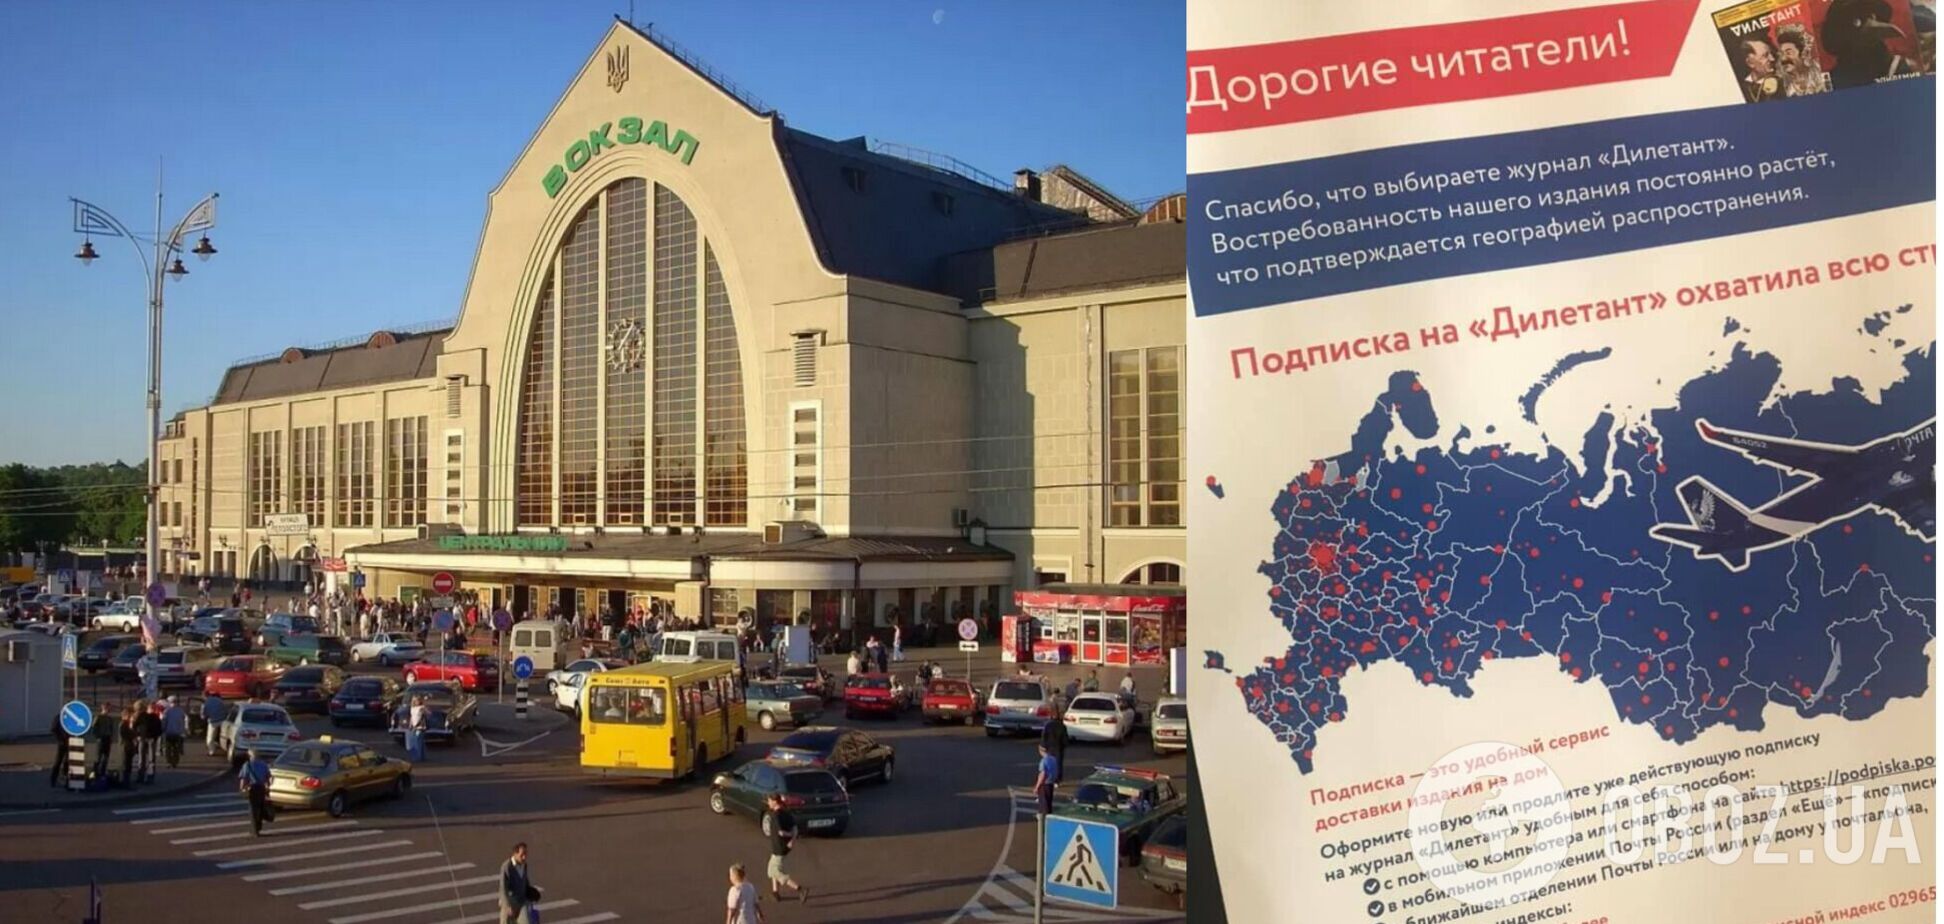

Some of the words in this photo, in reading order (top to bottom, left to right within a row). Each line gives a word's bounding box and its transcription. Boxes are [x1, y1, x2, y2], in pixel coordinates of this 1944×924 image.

[1186, 58, 1397, 113] Дорогие
[1410, 19, 1631, 79] читатели!
[541, 116, 700, 198] ВОКЗАЛ
[1205, 190, 1320, 221] Спасибо,
[1326, 184, 1366, 204] что
[1374, 166, 1501, 197] выбираете
[1507, 154, 1591, 181] журнал
[1598, 137, 1735, 167] «Дилетант».
[1211, 205, 1442, 254] Востребованность
[1448, 194, 1532, 219] нашего
[1538, 180, 1630, 207] издания
[1636, 165, 1753, 193] постоянно
[1759, 149, 1836, 179] растёт,
[1216, 266, 1259, 287] что
[1266, 234, 1466, 279] подтверждается
[1473, 212, 1606, 248] географией
[1612, 185, 1810, 232] распространения.
[1231, 331, 1411, 379] Подписка
[1420, 323, 1459, 347] на
[1469, 291, 1667, 341] «Дилетант»
[1675, 265, 1820, 307] охватила
[1827, 252, 1890, 281] всю
[1310, 773, 1405, 806] Подписка
[1430, 761, 1460, 779] это
[1464, 738, 1545, 774] удобный
[1549, 725, 1610, 751] сервис
[1315, 799, 1402, 833] доставки
[1407, 781, 1484, 809] издания
[1488, 775, 1508, 791] на
[1513, 766, 1548, 785] дом
[1320, 829, 1413, 859] Оформите
[1417, 814, 1473, 838] новую
[1512, 785, 1590, 813] продлите
[1593, 776, 1625, 796] уже
[1629, 749, 1741, 787] действующую
[1744, 732, 1820, 759] подписку
[1325, 867, 1345, 882] на
[1349, 851, 1414, 877] журнал
[1418, 826, 1519, 858] «Дилетант»
[1523, 807, 1597, 836] удобным
[1601, 798, 1629, 815] для
[1633, 786, 1669, 805] себя
[1672, 767, 1755, 795] способом:
[1384, 878, 1393, 890] с
[1397, 858, 1479, 886] помощью
[1483, 830, 1583, 866] компьютера
[1587, 823, 1618, 839] или
[1621, 801, 1706, 830] смартфона
[1711, 795, 1729, 809] на
[1733, 786, 1776, 804] сайте
[1388, 901, 1397, 913] в
[1402, 877, 1498, 910] мобильном
[1502, 849, 1605, 885] приложении
[1609, 834, 1661, 857] Почты
[1666, 820, 1722, 842] России
[1509, 872, 1597, 906] отделении
[1601, 859, 1653, 881] Почты
[1657, 845, 1715, 866] России
[1718, 835, 1748, 853] или
[1752, 831, 1771, 847] на
[1774, 824, 1815, 843] дому
[1818, 820, 1827, 837] у
[1831, 804, 1928, 829] почтальона,
[1829, 900, 1885, 921] индекс
